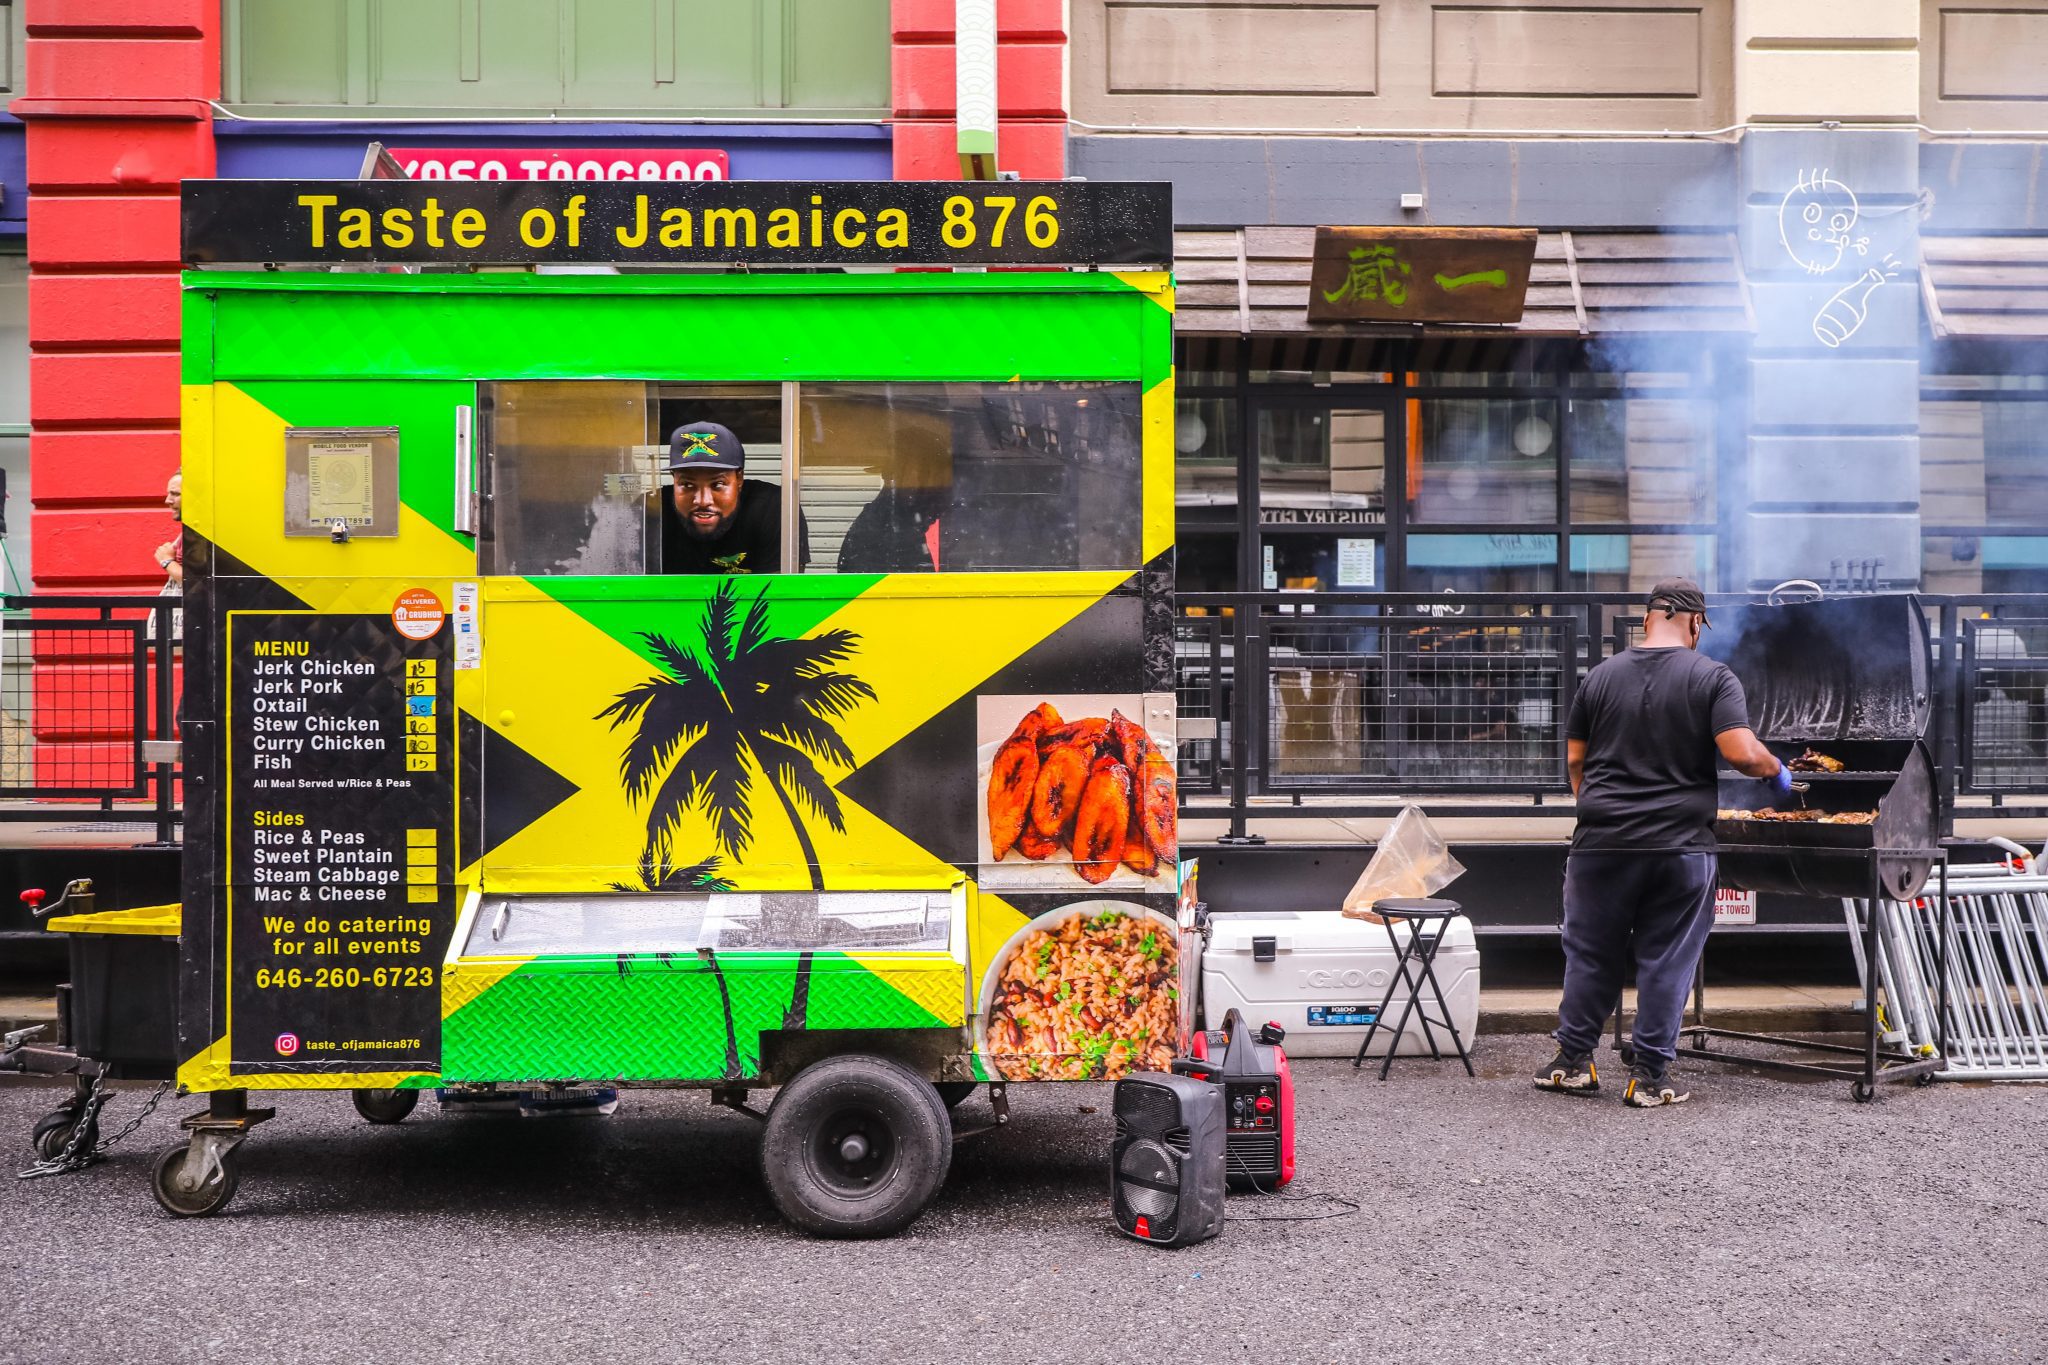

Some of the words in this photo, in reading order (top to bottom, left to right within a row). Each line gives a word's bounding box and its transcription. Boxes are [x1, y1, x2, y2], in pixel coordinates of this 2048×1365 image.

[298, 195, 487, 249] Taste
[519, 194, 587, 248] of
[615, 194, 909, 249] Jamaica
[941, 195, 1060, 249] 876
[254, 641, 309, 657] MENU
[253, 659, 294, 676] Jerk
[300, 659, 375, 675] Chicken
[253, 678, 294, 694] Jerk
[300, 678, 343, 694] Pork
[253, 697, 307, 713] Oxtail
[253, 716, 299, 732] Stew
[305, 715, 380, 732] Chicken
[253, 735, 304, 754] Curry
[310, 735, 386, 751] Chicken
[254, 754, 292, 769] Fish
[253, 779, 268, 788] All
[270, 779, 295, 788] Meal
[298, 778, 334, 788] Served
[336, 778, 373, 788] w/Rice
[375, 778, 383, 788] &
[386, 778, 412, 788] Peas
[253, 810, 305, 826] Sides
[254, 829, 295, 845] Rice
[301, 829, 314, 845] &
[320, 829, 365, 845] Peas
[253, 848, 310, 864] Sweet
[317, 847, 393, 864] Plantain
[253, 867, 311, 883] Steam
[318, 866, 400, 884] Cabbage
[254, 886, 293, 902] Mac
[299, 886, 312, 902] &
[318, 885, 387, 901] Cheese
[1715, 905, 1724, 914] BE
[1726, 905, 1750, 914] TOWED
[263, 916, 296, 934] We
[303, 916, 330, 934] do
[338, 915, 431, 936] catering
[273, 937, 306, 955] for
[313, 937, 339, 955] all
[347, 937, 421, 955] events
[256, 966, 434, 989] 646-260-6723
[1298, 969, 1390, 988] IGLOO
[306, 1038, 421, 1051] taste_ofjamaica876
